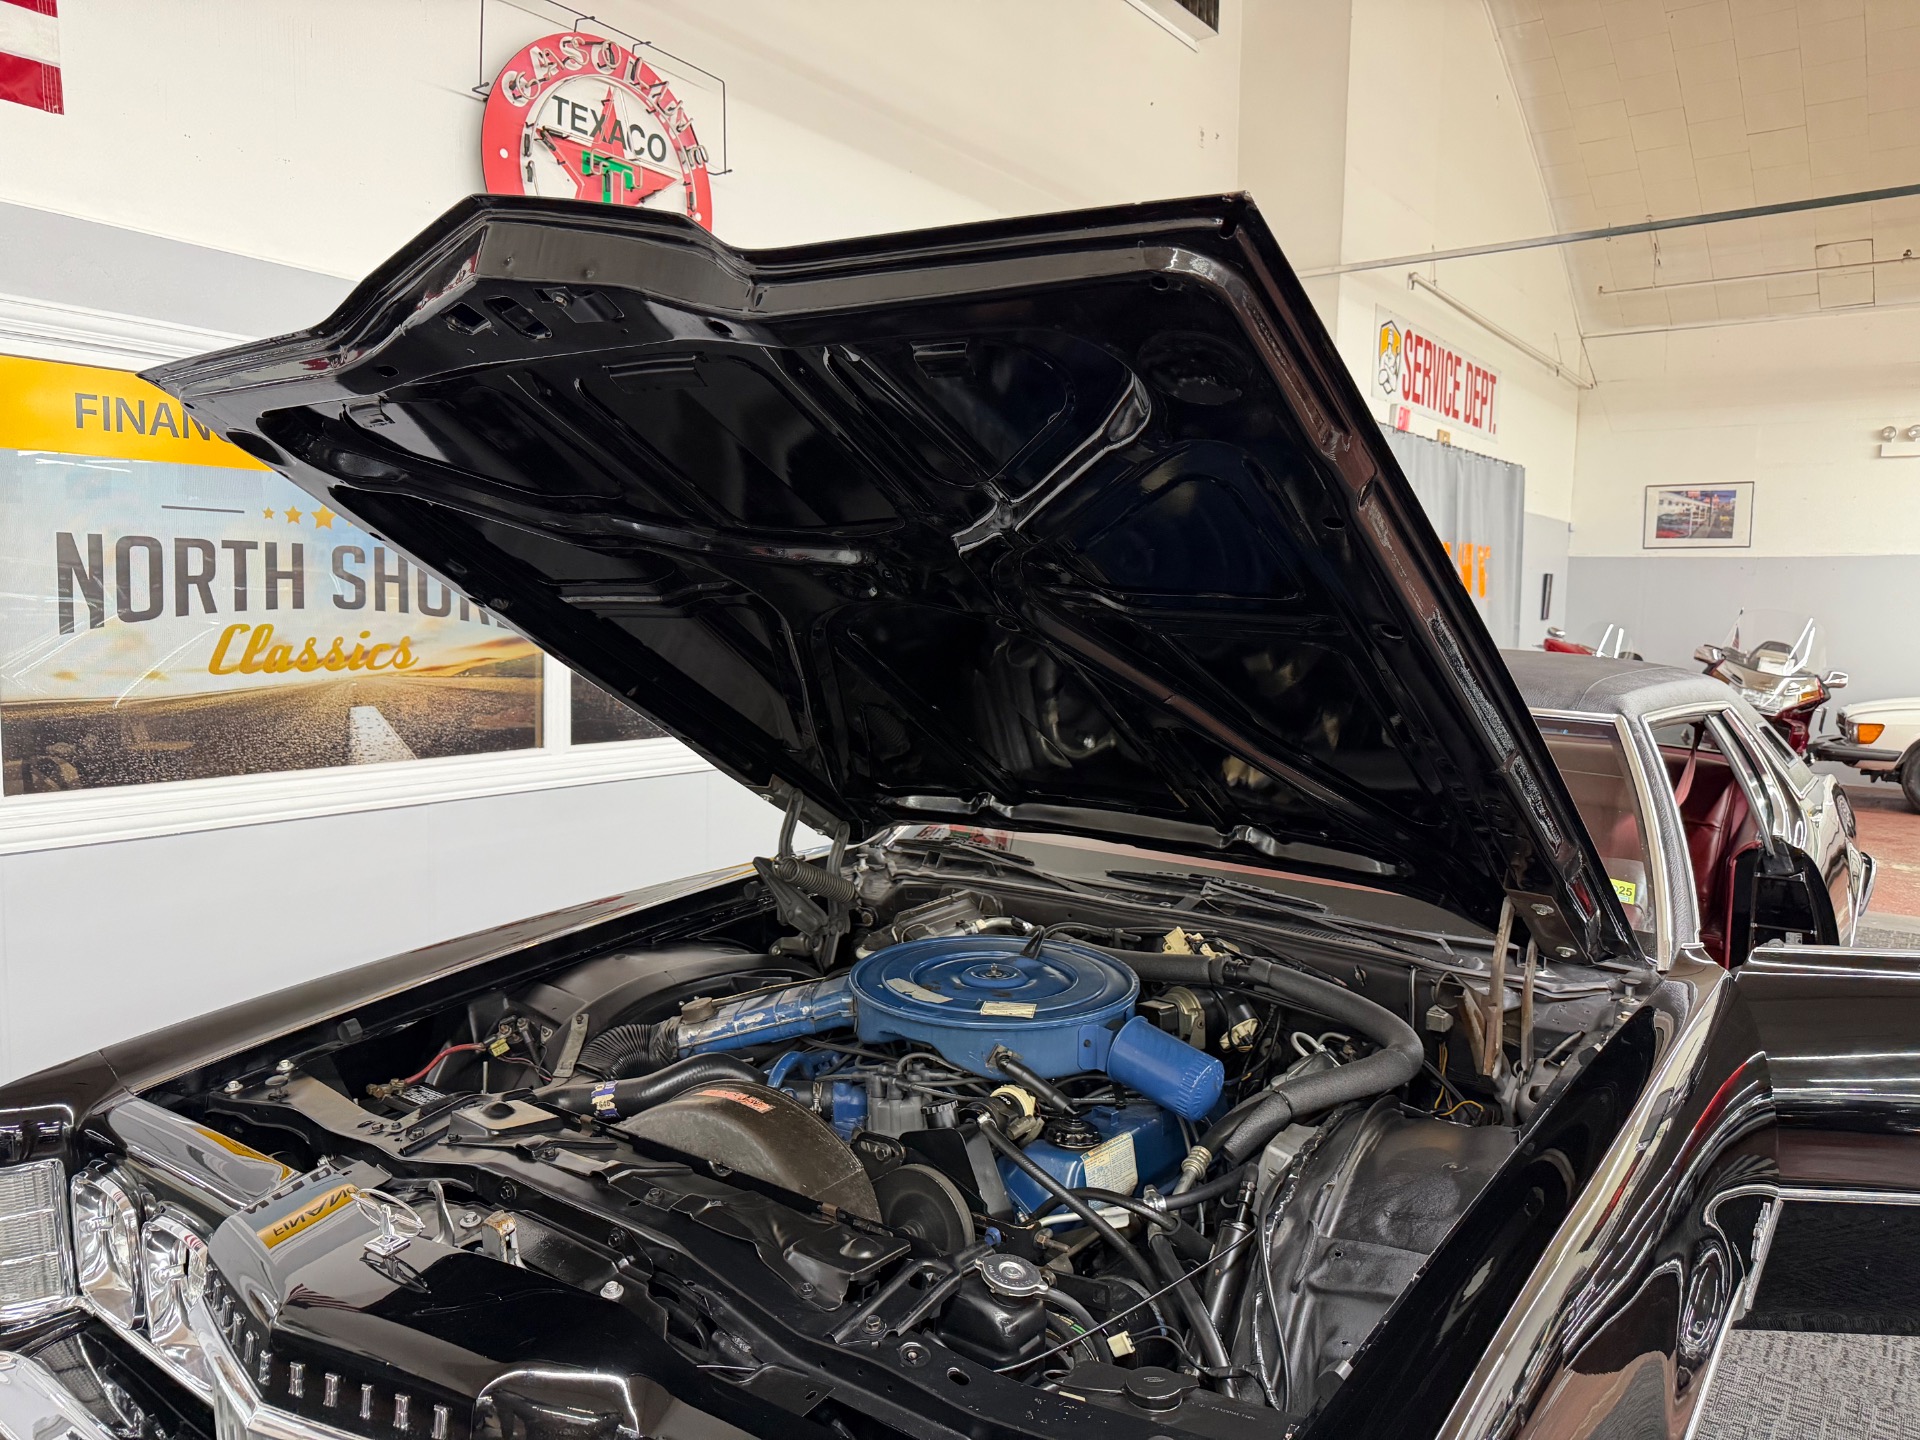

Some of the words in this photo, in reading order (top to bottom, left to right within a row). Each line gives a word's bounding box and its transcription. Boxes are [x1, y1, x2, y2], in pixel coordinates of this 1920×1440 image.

[552, 95, 667, 163] TEXACO
[1402, 329, 1462, 420] SERVICE
[1463, 361, 1497, 435] DEPT.
[75, 392, 231, 444] FINAN
[55, 531, 306, 635] NORTH
[331, 545, 511, 630] SHO
[208, 623, 420, 677] Classics
[1618, 885, 1633, 897] 25
